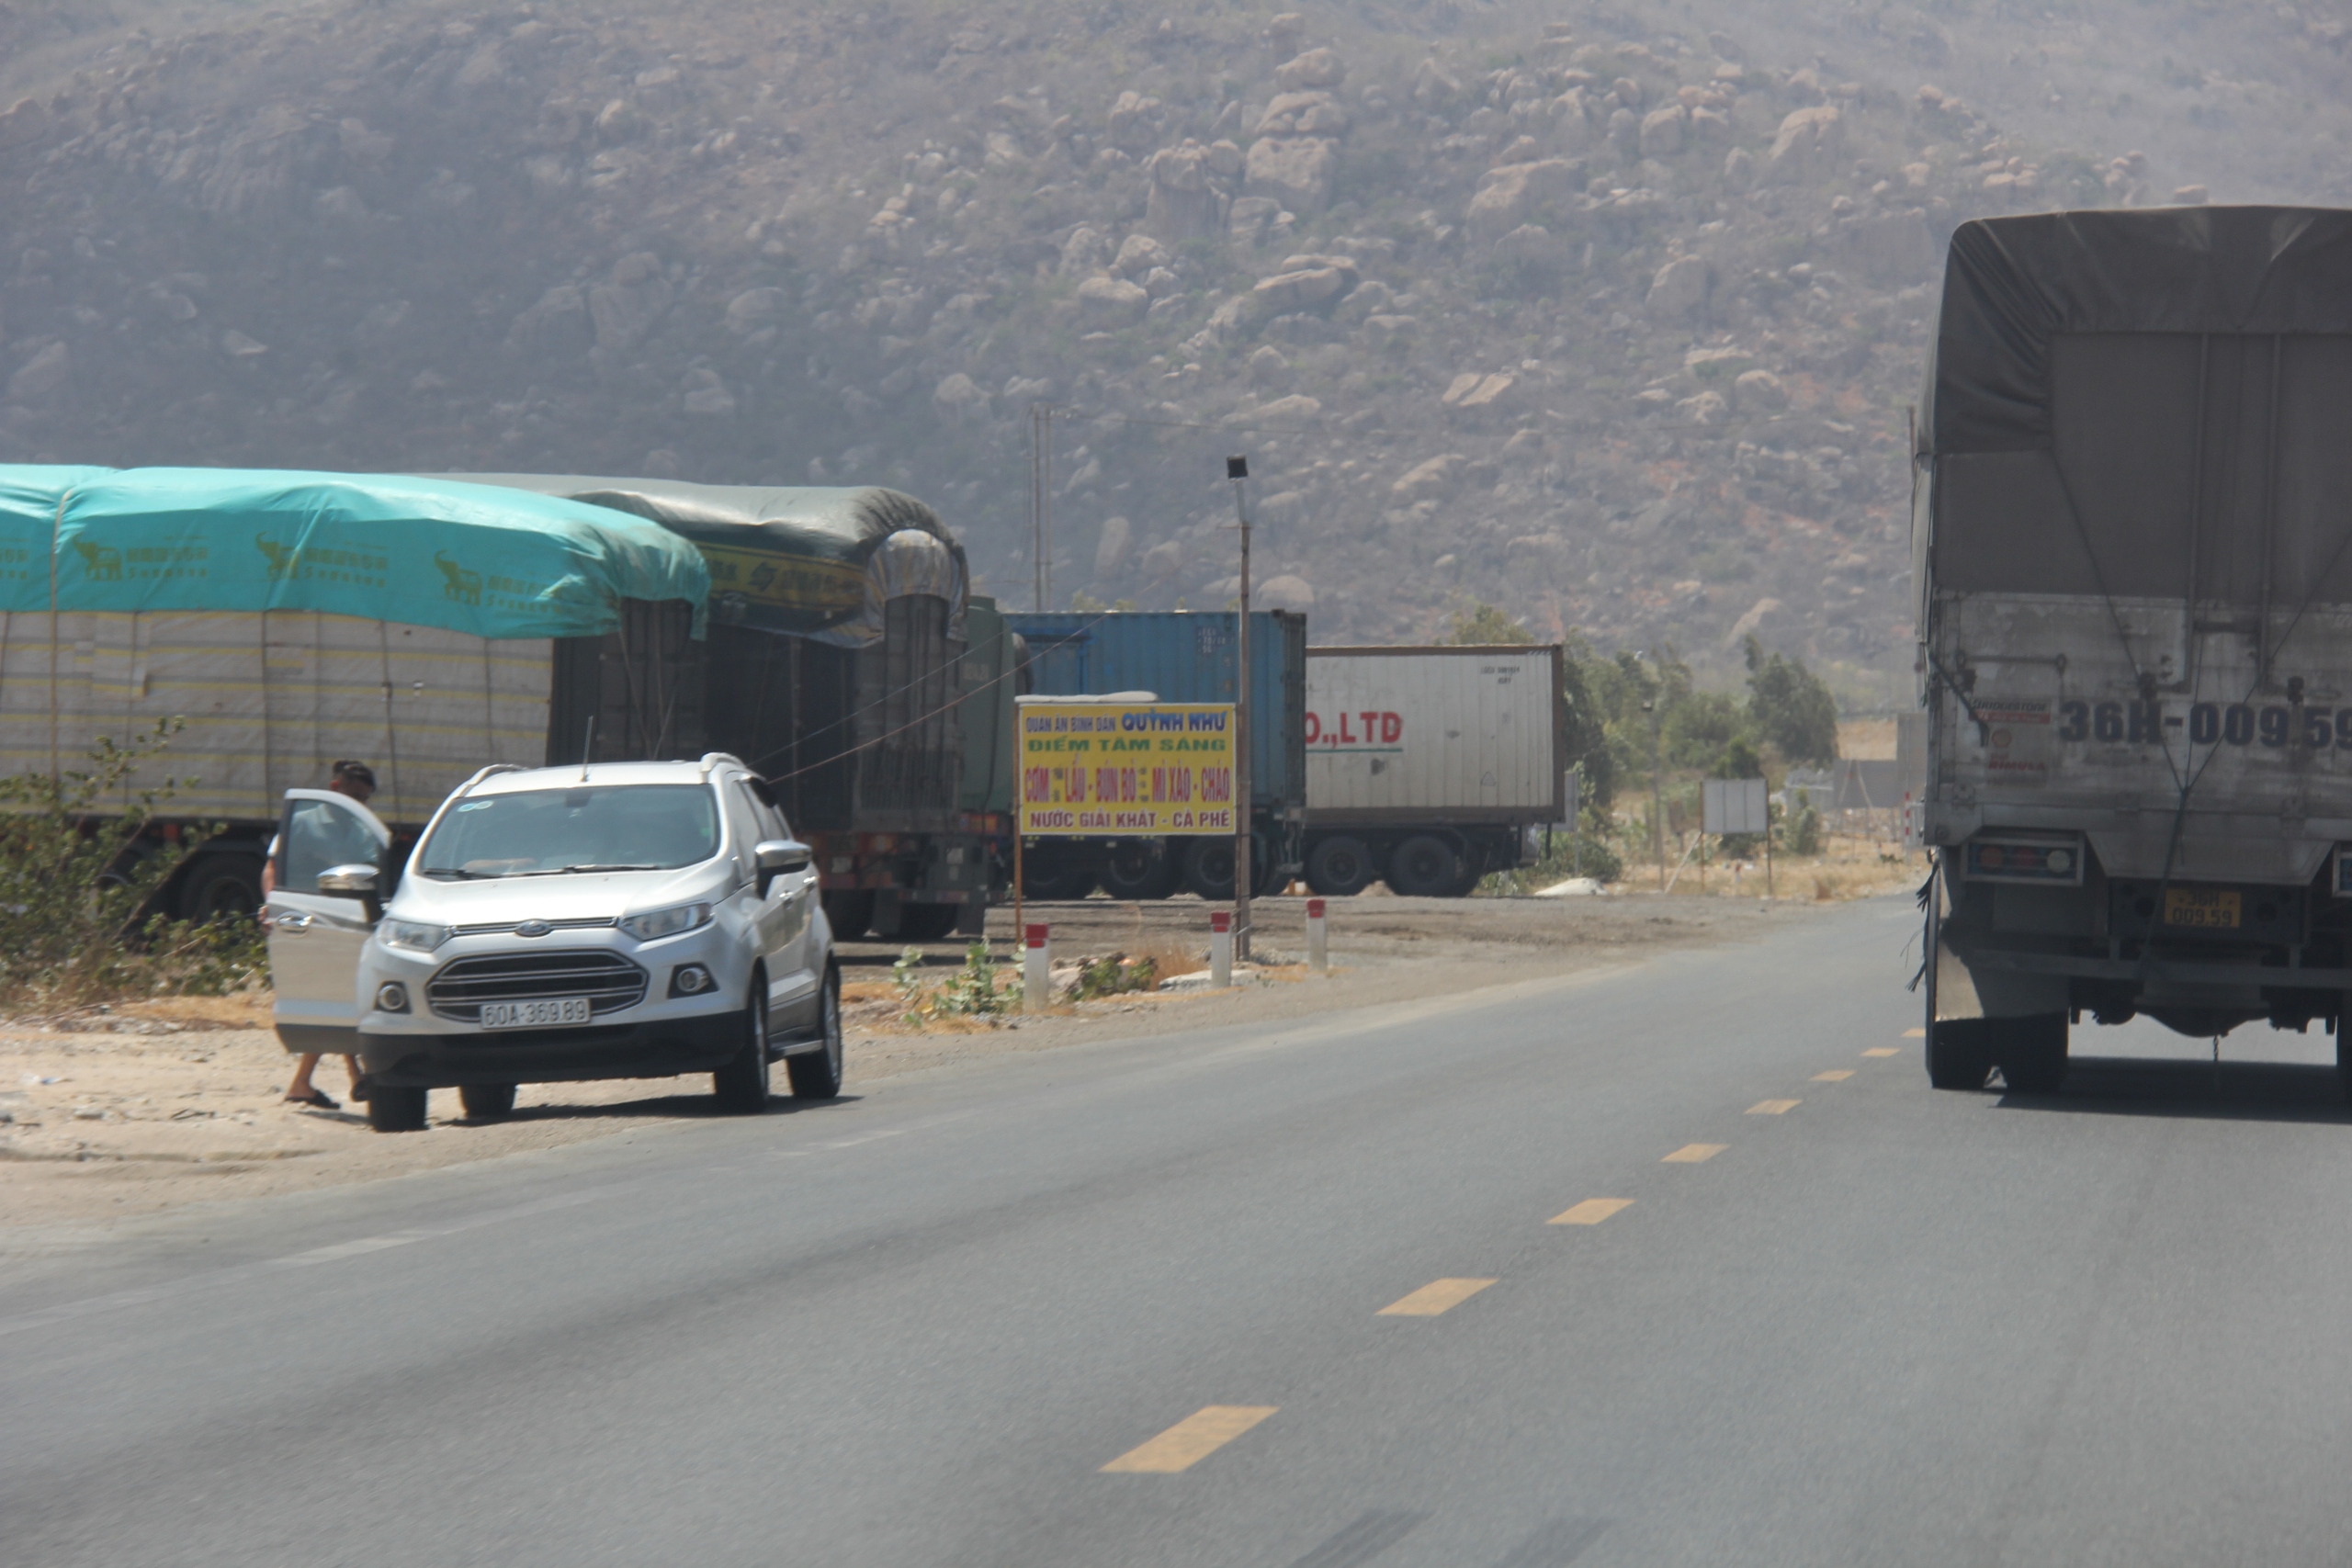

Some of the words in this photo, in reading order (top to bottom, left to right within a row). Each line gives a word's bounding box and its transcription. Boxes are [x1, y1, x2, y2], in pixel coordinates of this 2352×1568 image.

[1122, 707, 1183, 731] QUỲNH
[1188, 710, 1227, 731] NHƯ
[1099, 737, 1150, 751] TÂM
[1159, 737, 1226, 751] SÁNG
[1025, 764, 1050, 803] CƠM
[1169, 759, 1191, 803] XÀO
[1202, 759, 1230, 803] CHÁO
[1030, 808, 1074, 828] NƯỚC
[1080, 807, 1110, 828] GIẢI
[1116, 808, 1157, 828] KHÁT
[1172, 808, 1193, 828] CÀ
[1199, 808, 1230, 828] PHÊ
